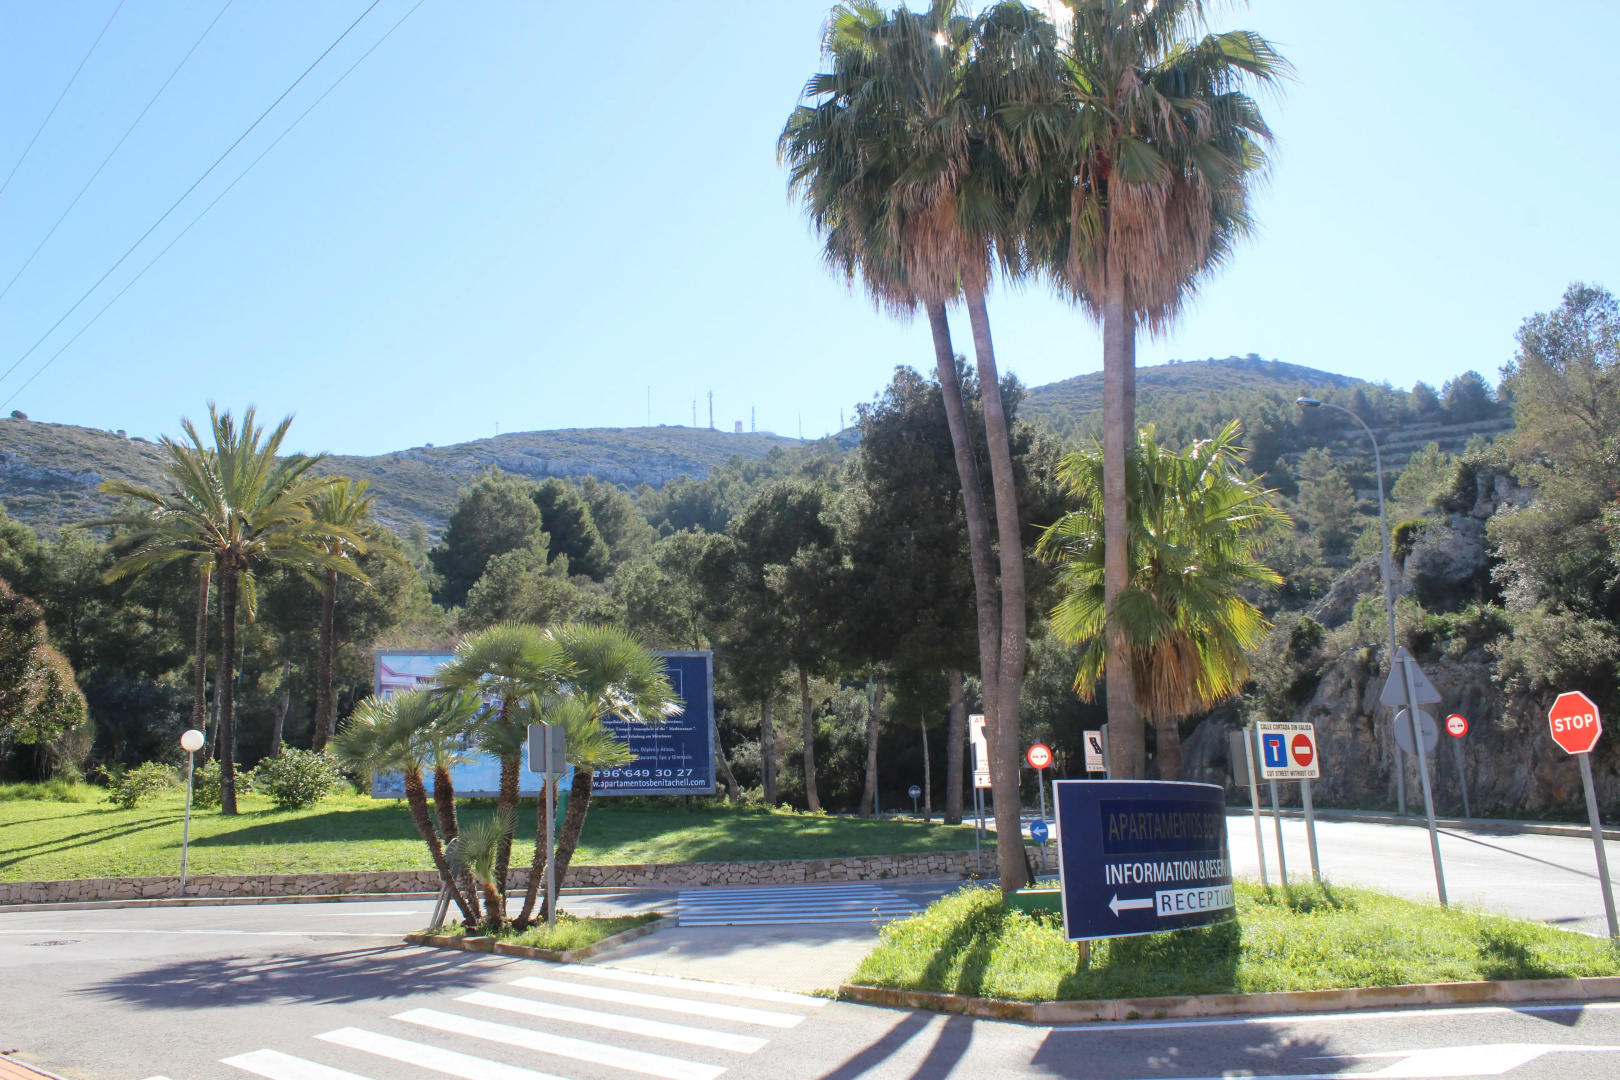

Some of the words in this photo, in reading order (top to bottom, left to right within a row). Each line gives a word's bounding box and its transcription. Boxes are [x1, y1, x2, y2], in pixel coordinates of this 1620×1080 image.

[1554, 713, 1594, 733] STOP
[602, 769, 620, 778] 96
[625, 769, 650, 777] 649
[655, 769, 672, 777] 30
[677, 768, 693, 777] 27
[592, 778, 706, 789] w.apartamentosbenitachell.com
[1108, 812, 1203, 841] APARTAMENTOS
[1105, 860, 1198, 885] INFORMATION
